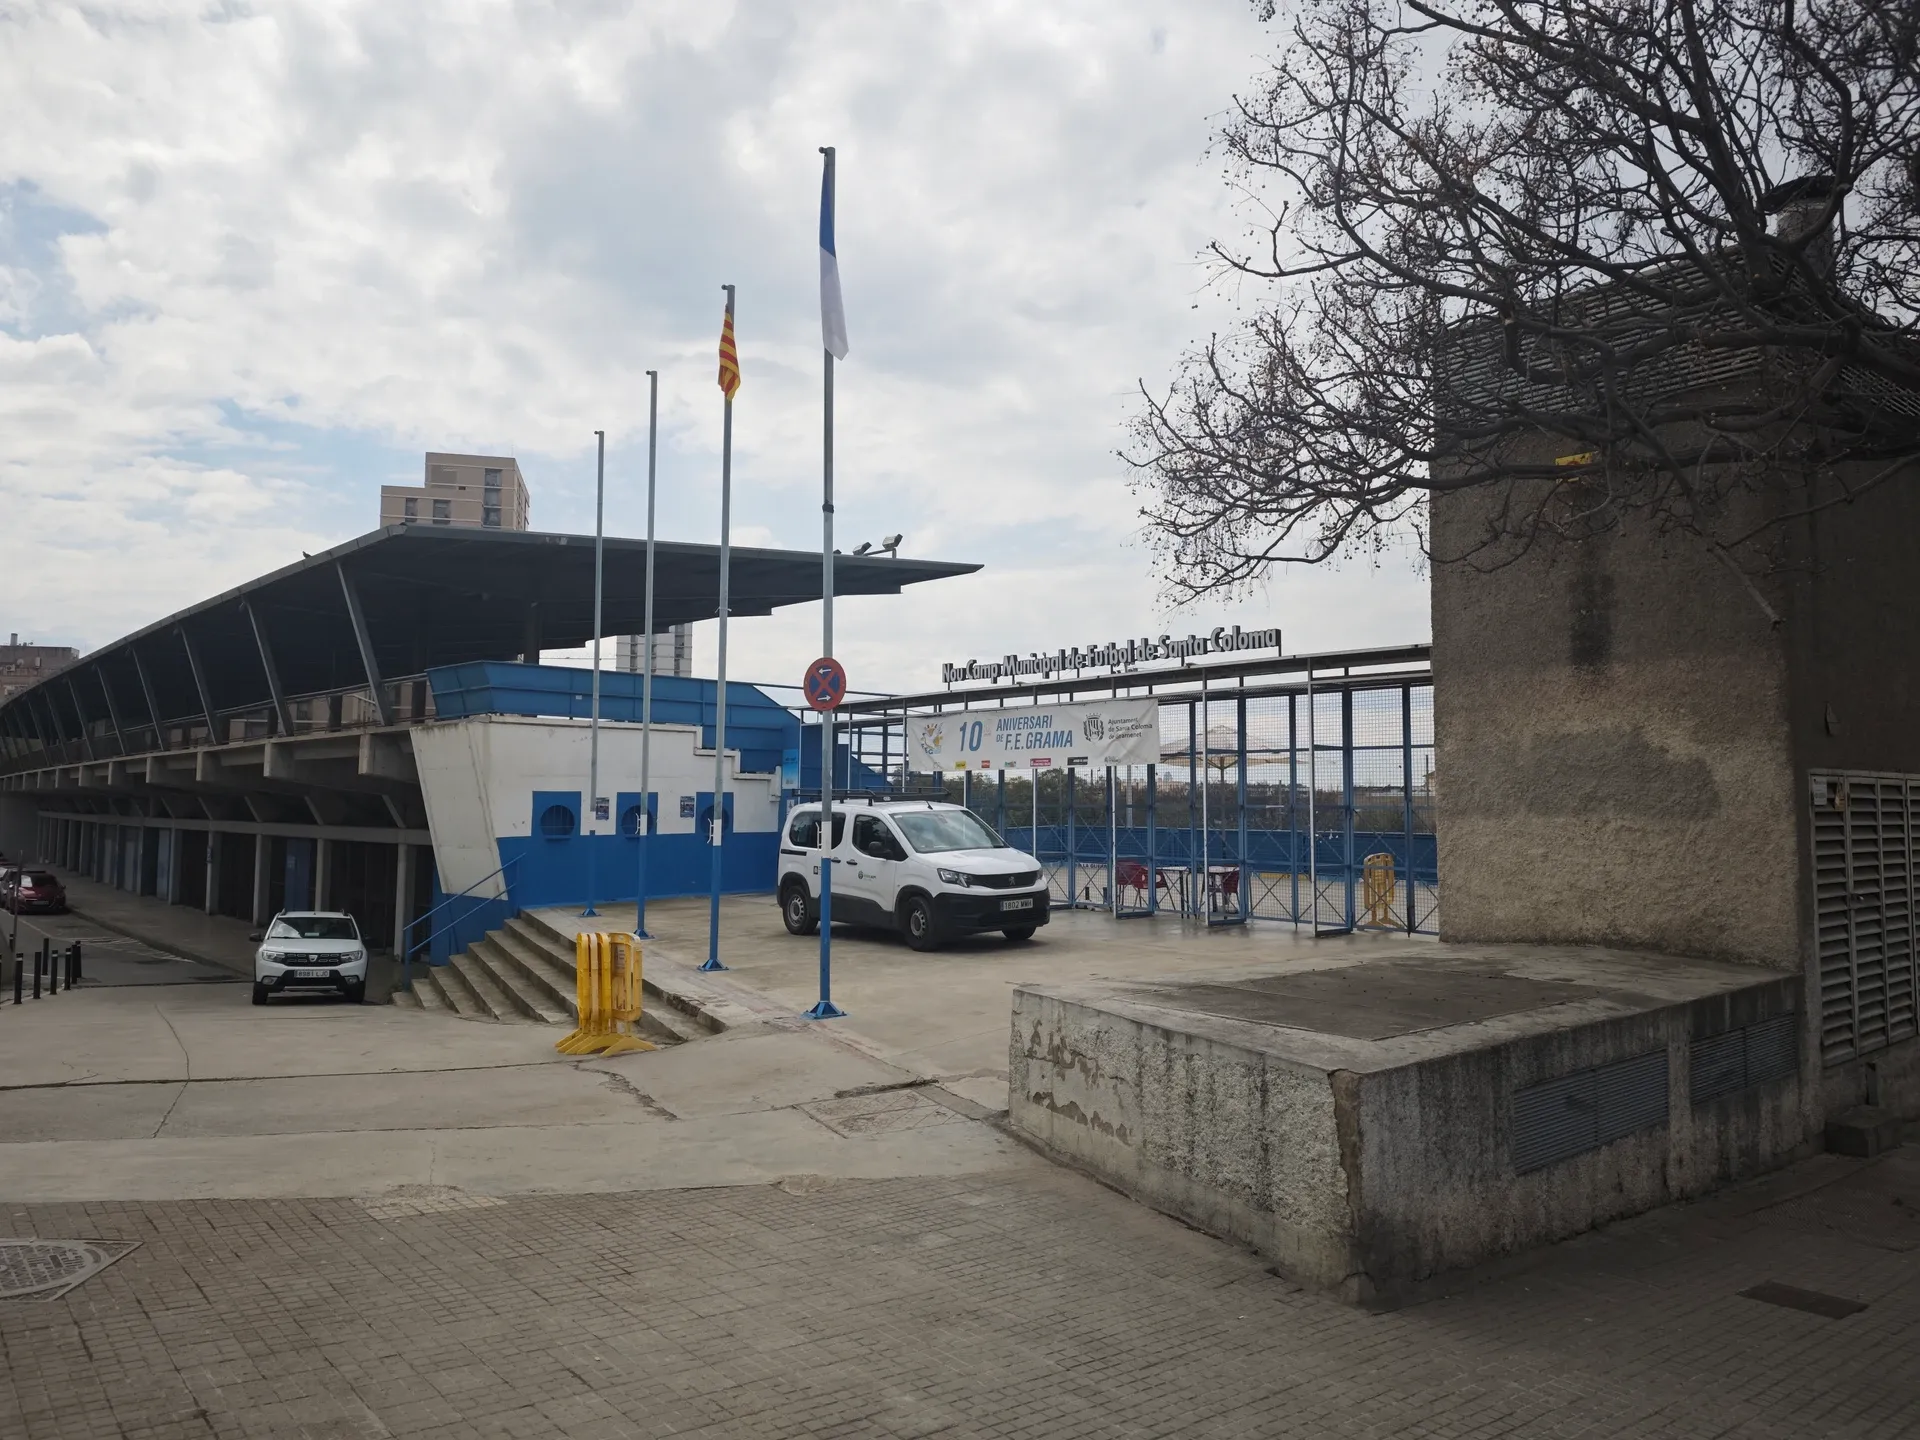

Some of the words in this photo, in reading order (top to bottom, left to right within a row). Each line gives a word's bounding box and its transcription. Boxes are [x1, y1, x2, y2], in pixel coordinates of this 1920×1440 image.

[942, 663, 964, 683] Nou
[966, 659, 1001, 684] Camp
[1002, 648, 1066, 679] Municipal
[1065, 647, 1086, 669] de
[1087, 639, 1135, 668] Futbol
[1136, 637, 1158, 661] de
[1158, 634, 1208, 659] Santa
[1211, 625, 1281, 651] Coloma
[996, 714, 1053, 731] ANIVERSARI
[960, 720, 983, 752] 10
[996, 733, 1004, 742] DE
[1004, 900, 1019, 910] 1802
